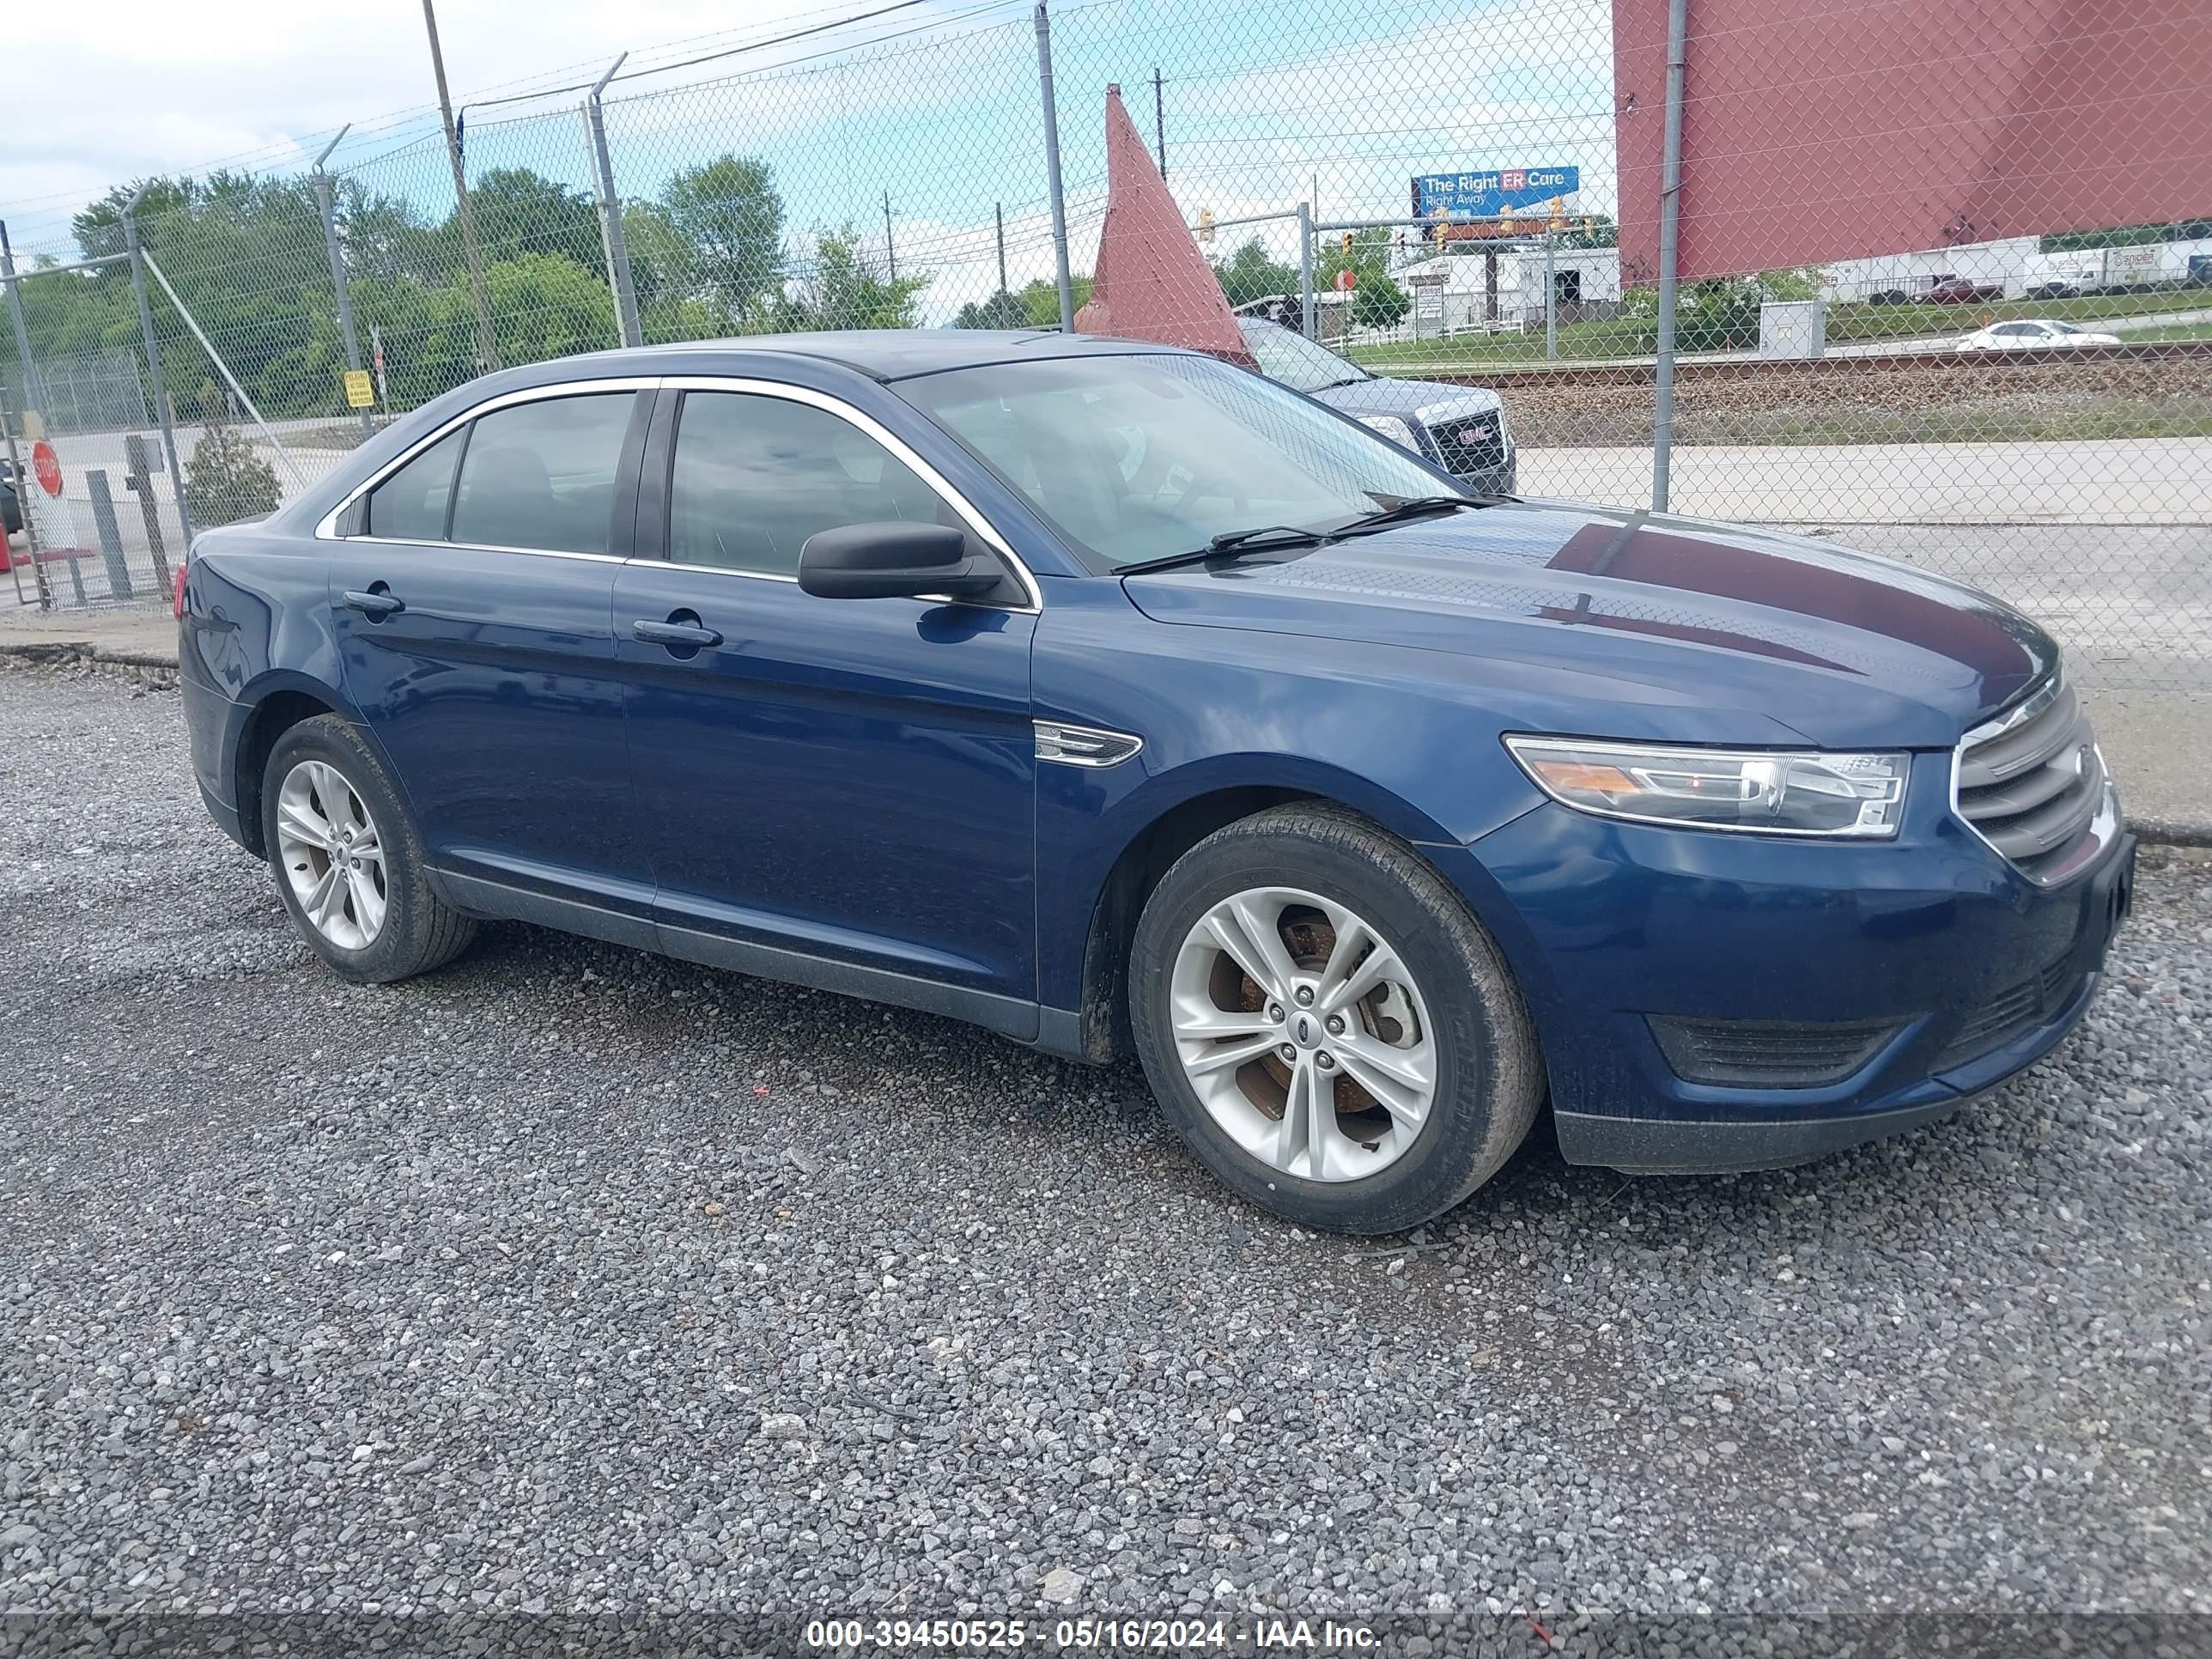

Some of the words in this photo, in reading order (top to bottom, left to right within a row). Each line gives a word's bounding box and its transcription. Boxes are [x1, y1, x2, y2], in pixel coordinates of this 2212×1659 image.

[1425, 178, 1454, 193] The
[1458, 174, 1498, 193] Right
[1503, 173, 1523, 188] ER
[1528, 172, 1565, 186] Care
[1425, 195, 1454, 208] Right
[1456, 192, 1486, 206] Away
[2124, 253, 2154, 262] SNIDER
[1459, 425, 1492, 445] GMC
[35, 459, 56, 478] STOP
